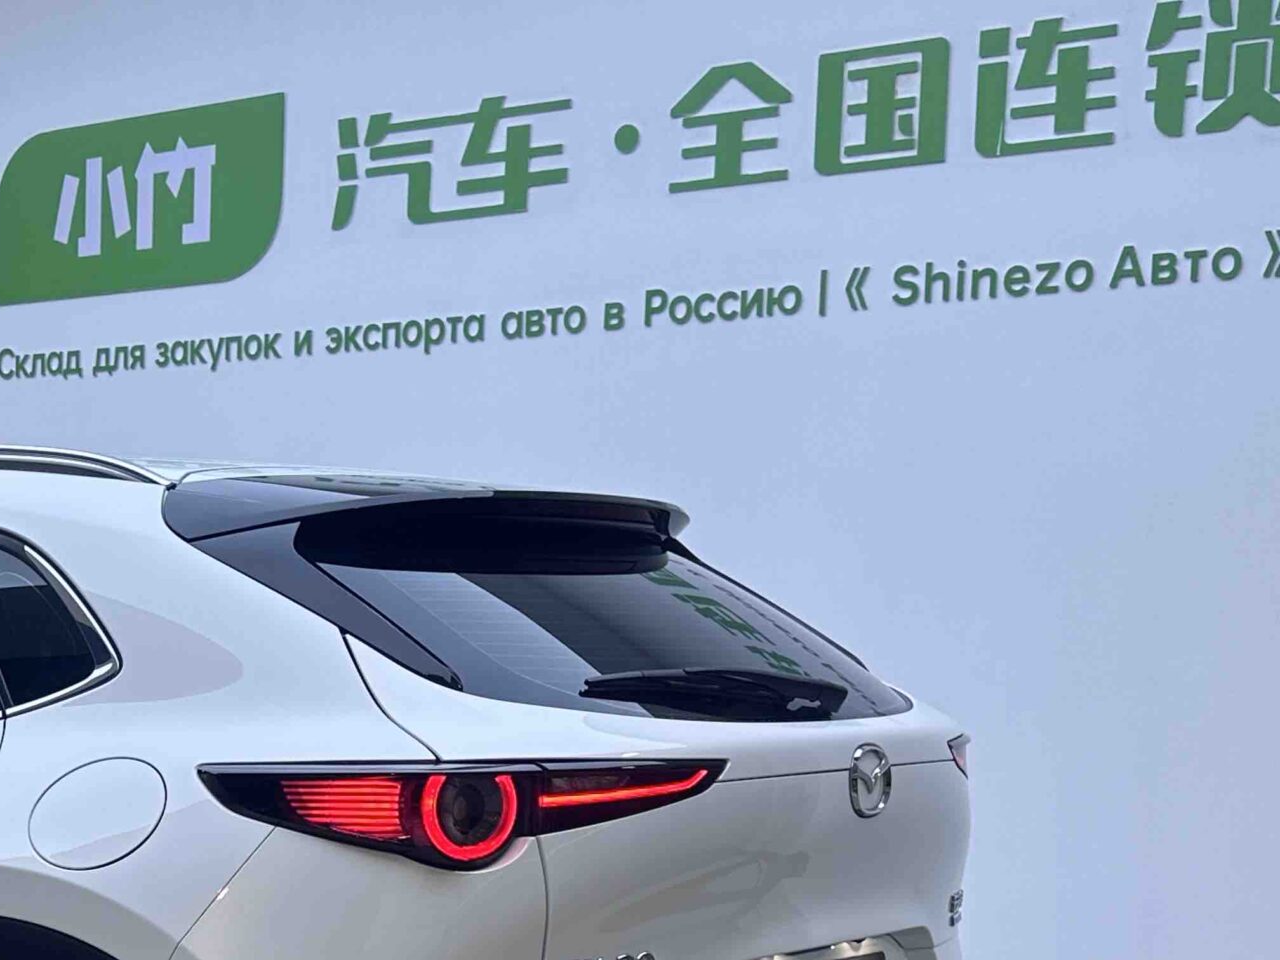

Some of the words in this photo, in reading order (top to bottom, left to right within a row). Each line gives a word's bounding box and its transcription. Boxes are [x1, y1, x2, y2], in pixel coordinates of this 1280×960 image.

[52, 135, 217, 258] 小竹
[92, 343, 146, 373] для
[155, 330, 281, 372] закупок
[294, 330, 313, 355] и
[326, 310, 486, 357] экспорта
[501, 305, 587, 341] авто
[604, 302, 627, 331] в
[644, 284, 803, 327] Россию
[892, 256, 1095, 307] Shinezo
[1109, 245, 1243, 290] Авто
